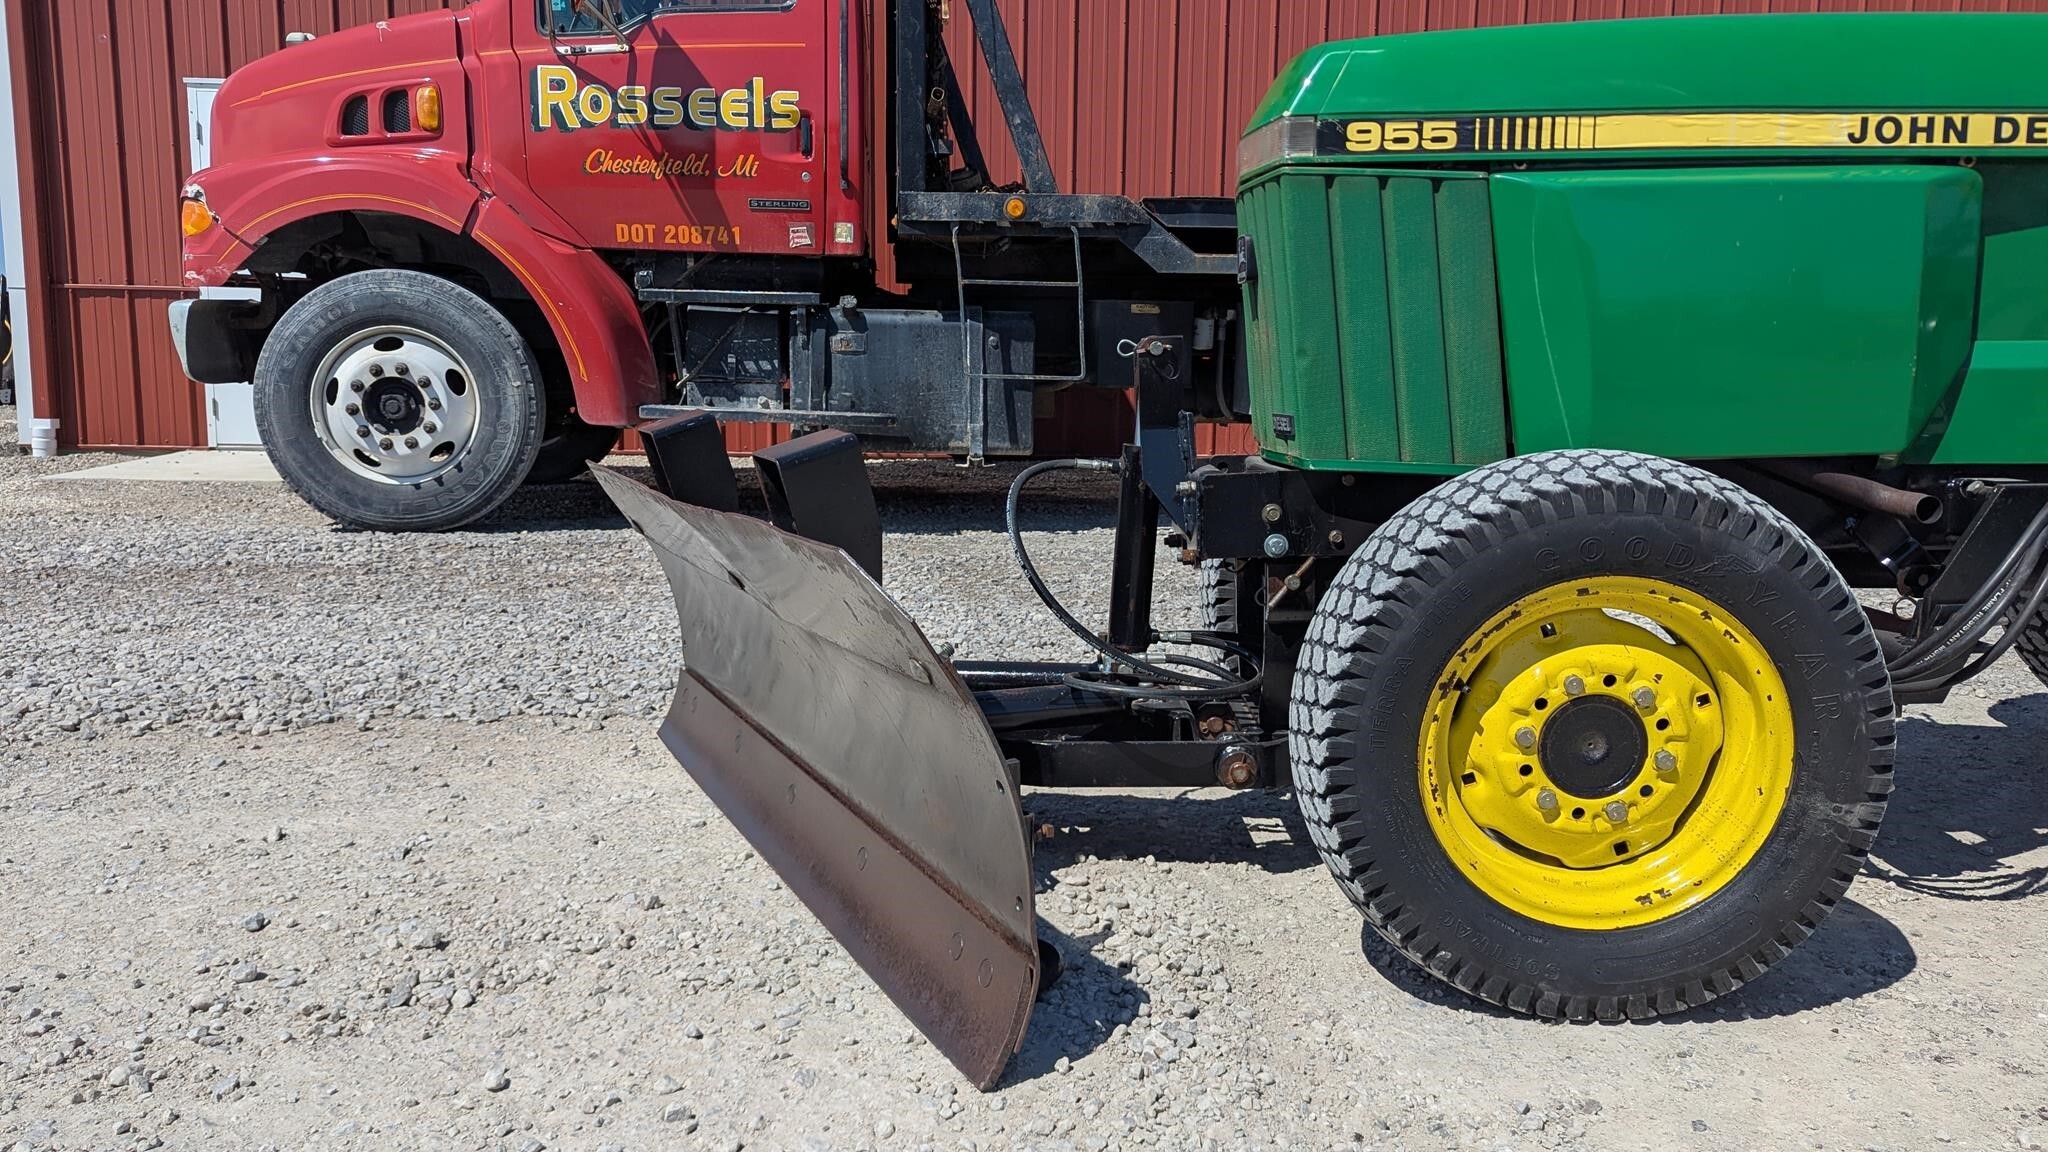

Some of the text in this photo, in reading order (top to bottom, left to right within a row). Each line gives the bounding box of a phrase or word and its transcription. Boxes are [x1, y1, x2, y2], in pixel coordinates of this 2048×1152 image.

[1345, 121, 1458, 152] 955
[1847, 116, 1969, 144] JOHN
[717, 155, 760, 178] Mi
[750, 200, 808, 209] STERLING
[615, 223, 741, 246] DOT 208741
